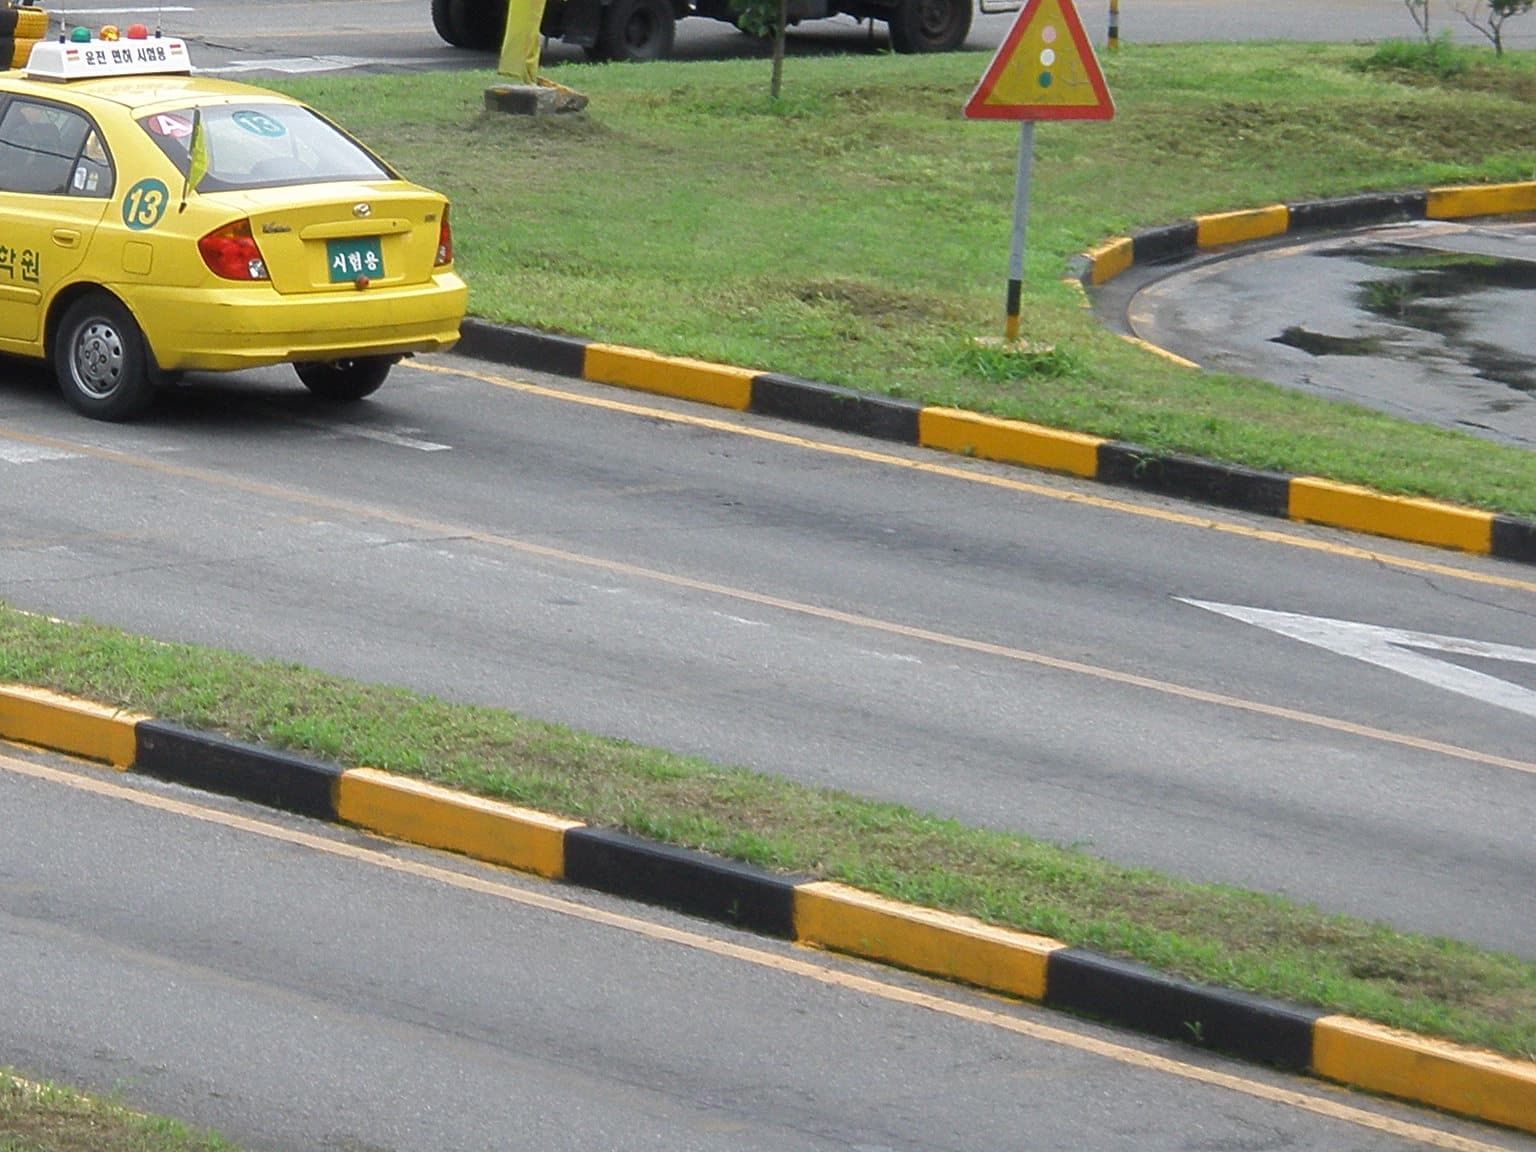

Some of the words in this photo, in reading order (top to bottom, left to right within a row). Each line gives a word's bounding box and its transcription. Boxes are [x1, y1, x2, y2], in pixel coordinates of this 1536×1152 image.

[85, 50, 107, 65] 운전
[112, 48, 133, 64] 면허
[137, 47, 166, 62] 시험용
[159, 116, 180, 135] A
[241, 112, 279, 136] 13
[127, 188, 162, 225] 13
[332, 250, 380, 274] 시험용
